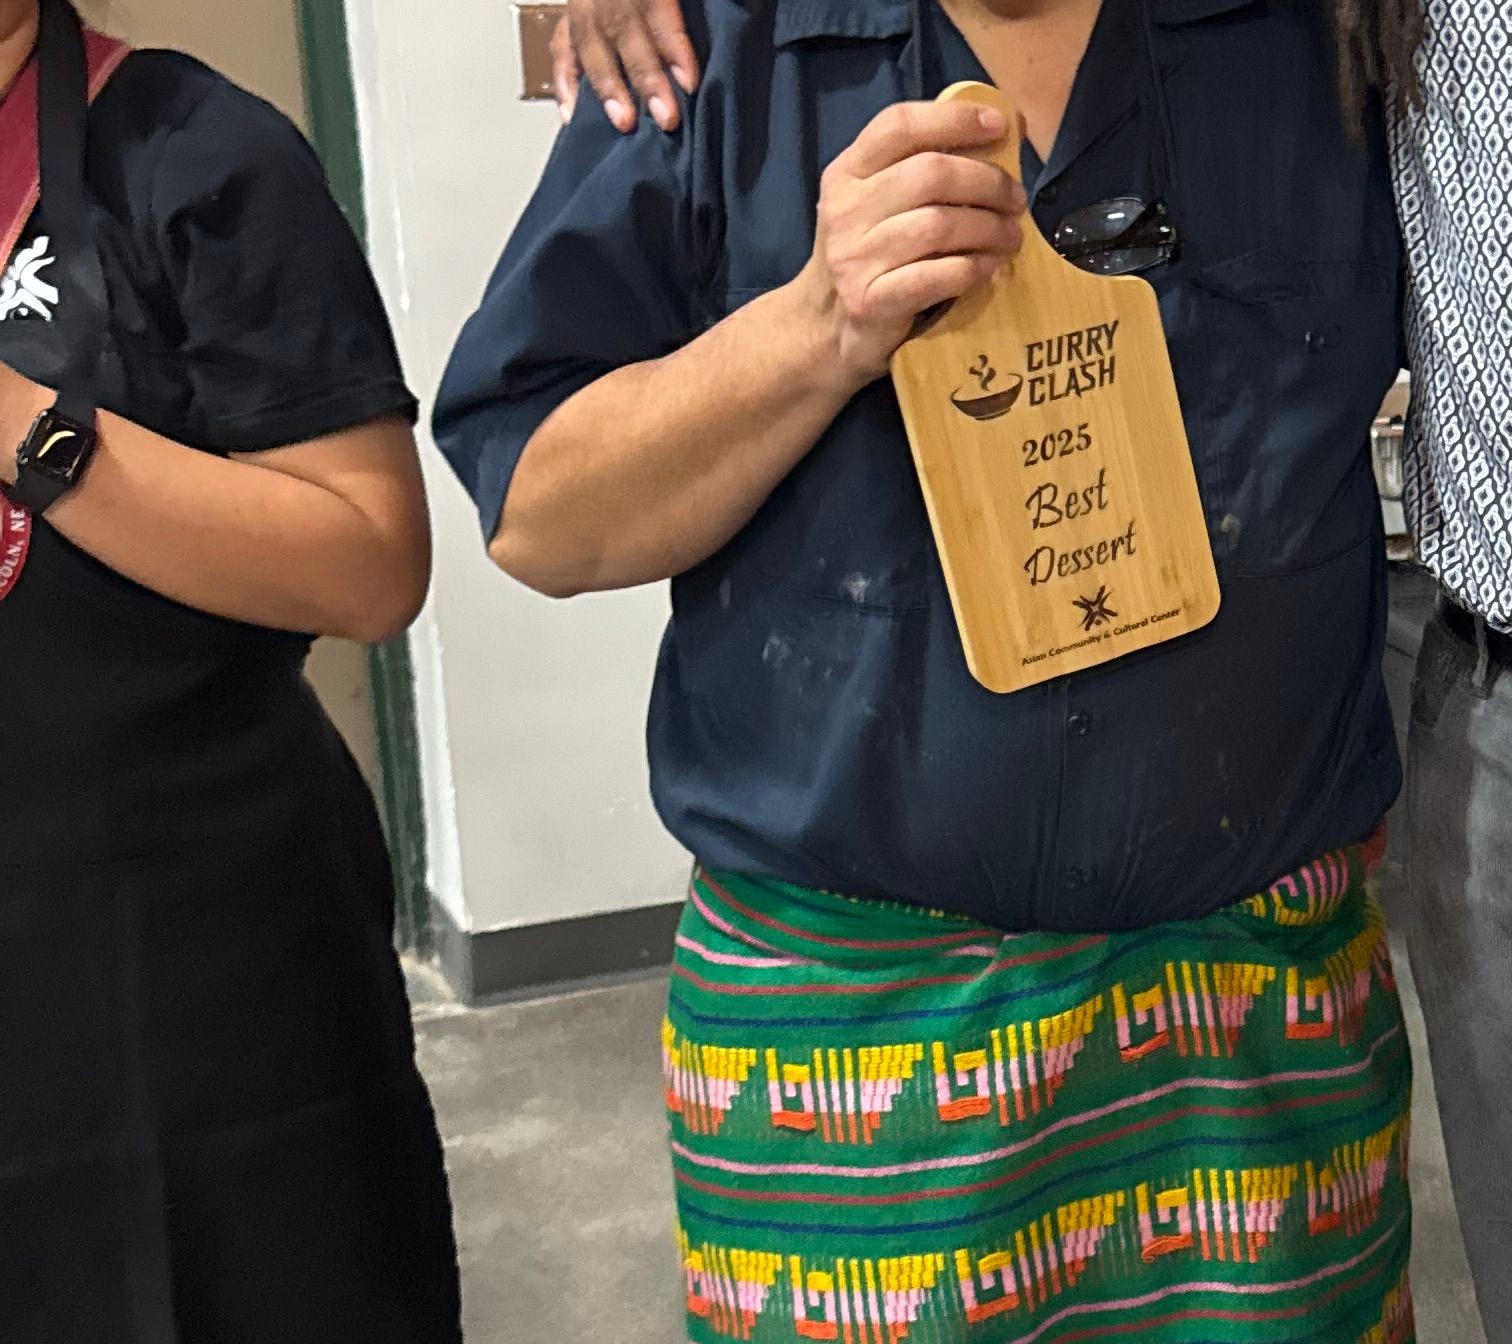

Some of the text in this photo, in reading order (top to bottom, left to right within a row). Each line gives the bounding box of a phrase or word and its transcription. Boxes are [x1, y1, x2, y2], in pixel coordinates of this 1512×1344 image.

[1025, 320, 1119, 372] CURRY
[1028, 356, 1115, 407] CLASH
[1022, 423, 1092, 467] 2025
[10, 509, 26, 531] NE
[1025, 467, 1109, 530] Best
[1024, 520, 1137, 586] Dessert
[1021, 607, 1181, 666] Asian Community & Cultural Center
